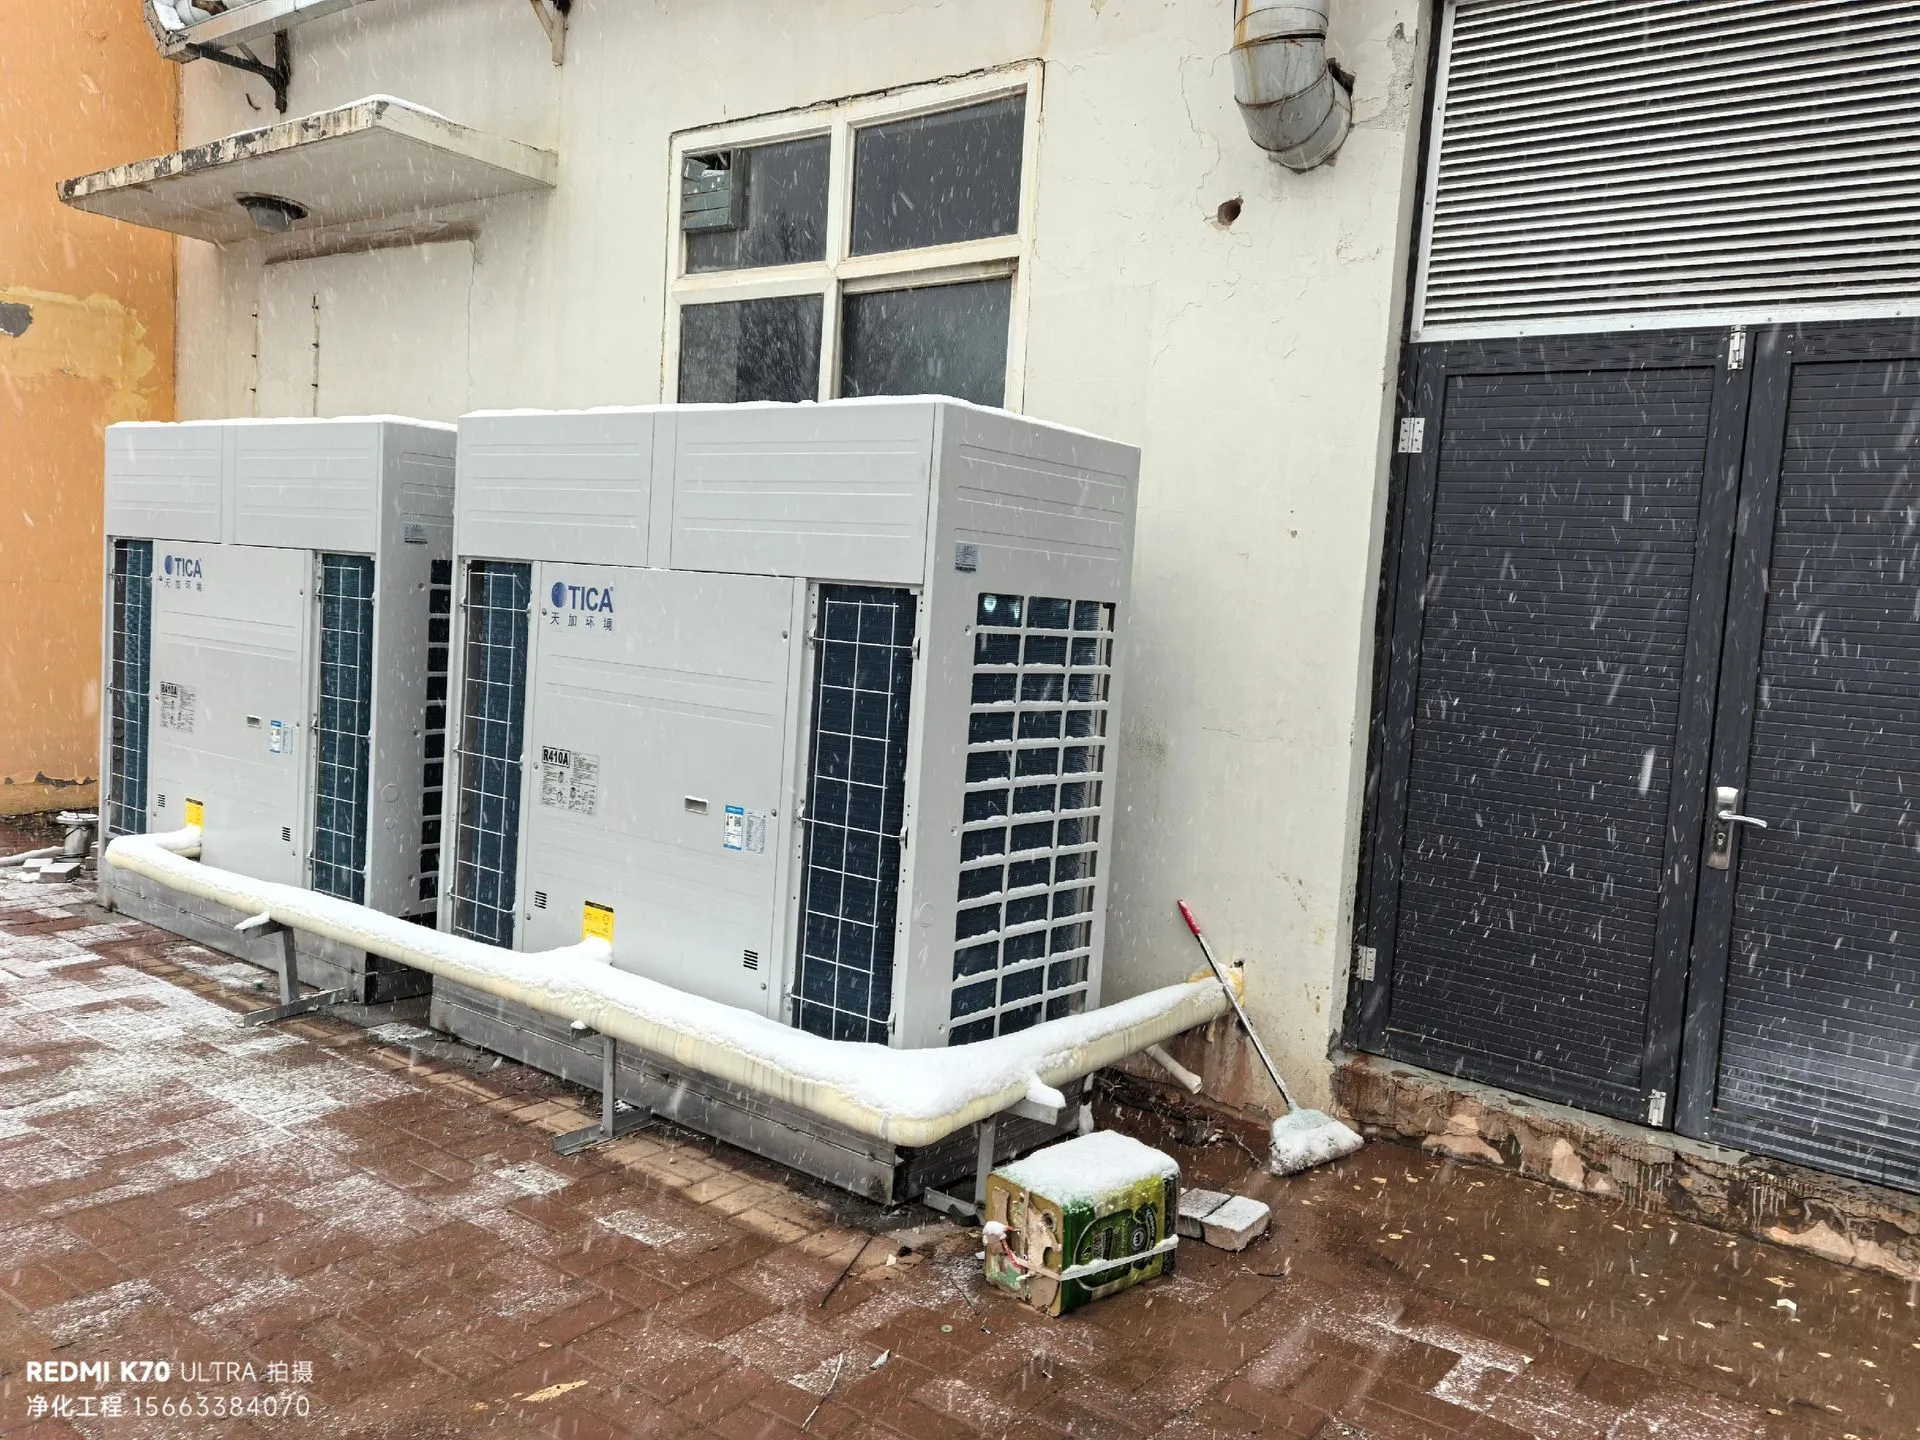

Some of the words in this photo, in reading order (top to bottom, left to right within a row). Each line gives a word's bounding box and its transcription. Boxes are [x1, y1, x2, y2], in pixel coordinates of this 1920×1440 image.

[174, 557, 202, 578] TICA
[568, 585, 614, 613] TICA
[550, 611, 613, 631] 天加环境
[543, 749, 569, 766] R410A
